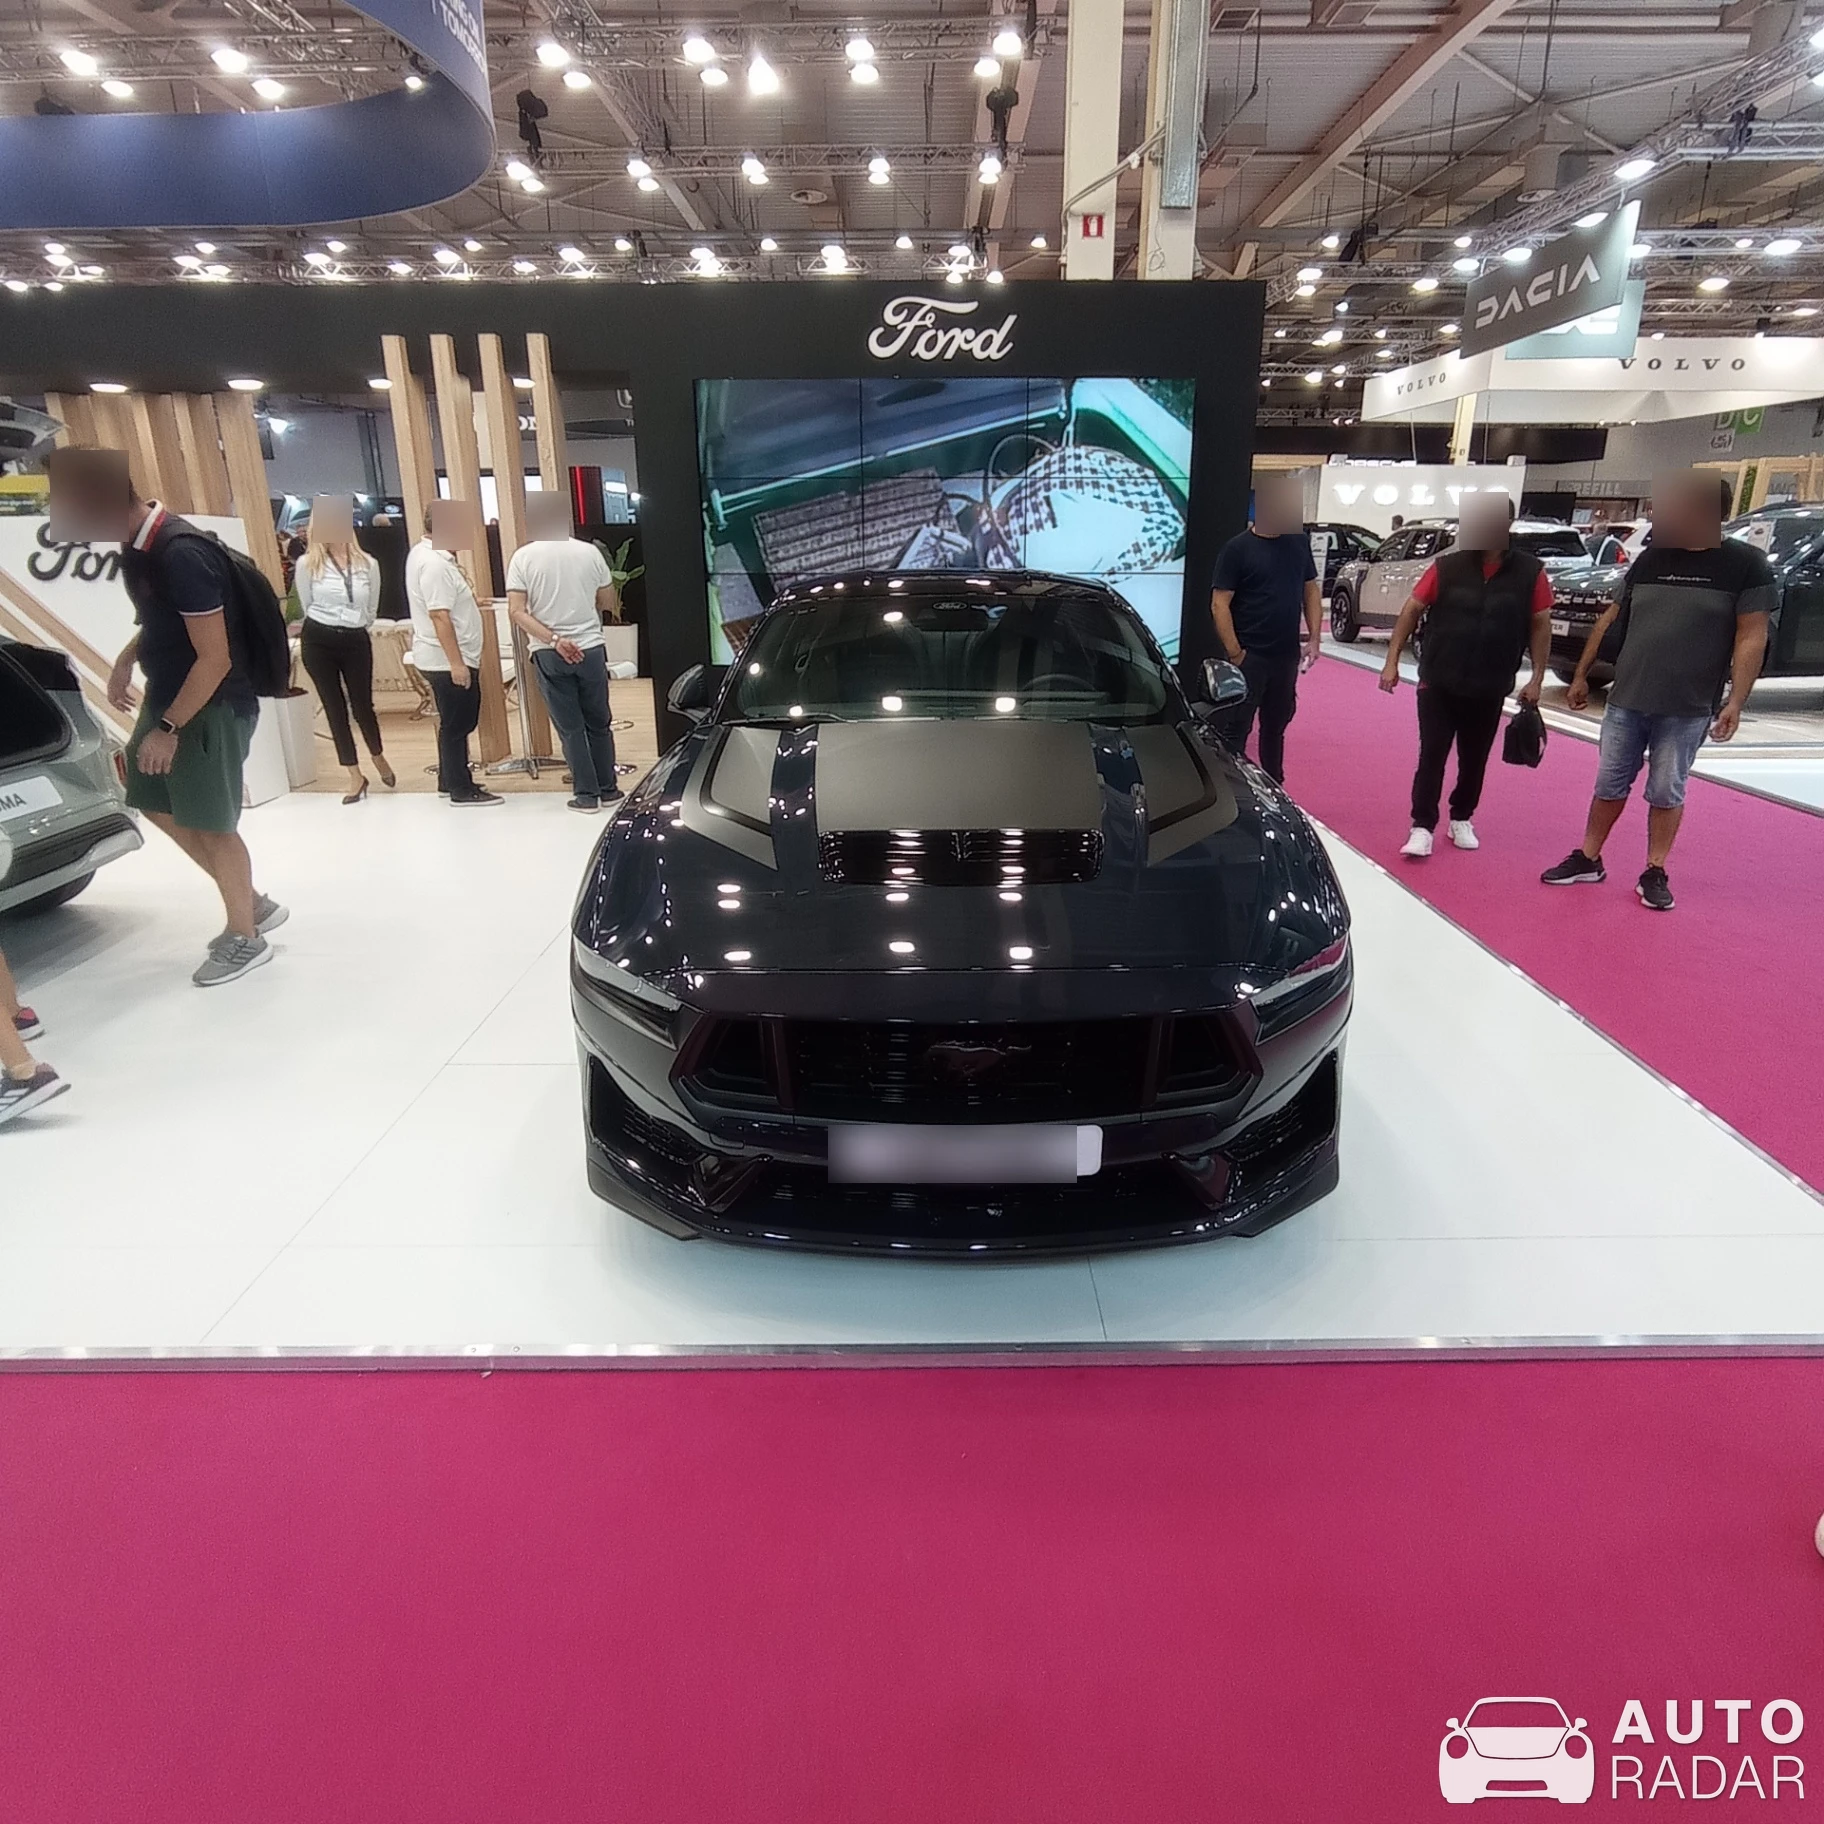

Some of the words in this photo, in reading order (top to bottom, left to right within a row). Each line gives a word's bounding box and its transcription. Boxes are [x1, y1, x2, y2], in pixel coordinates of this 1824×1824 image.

[1475, 253, 1601, 329] DACIA
[868, 296, 1018, 361] Ford
[1619, 357, 1745, 371] VOLVO
[1396, 372, 1447, 396] VOLVO
[1333, 484, 1509, 506] VOLV
[27, 521, 123, 581] For
[0, 793, 27, 813] MA
